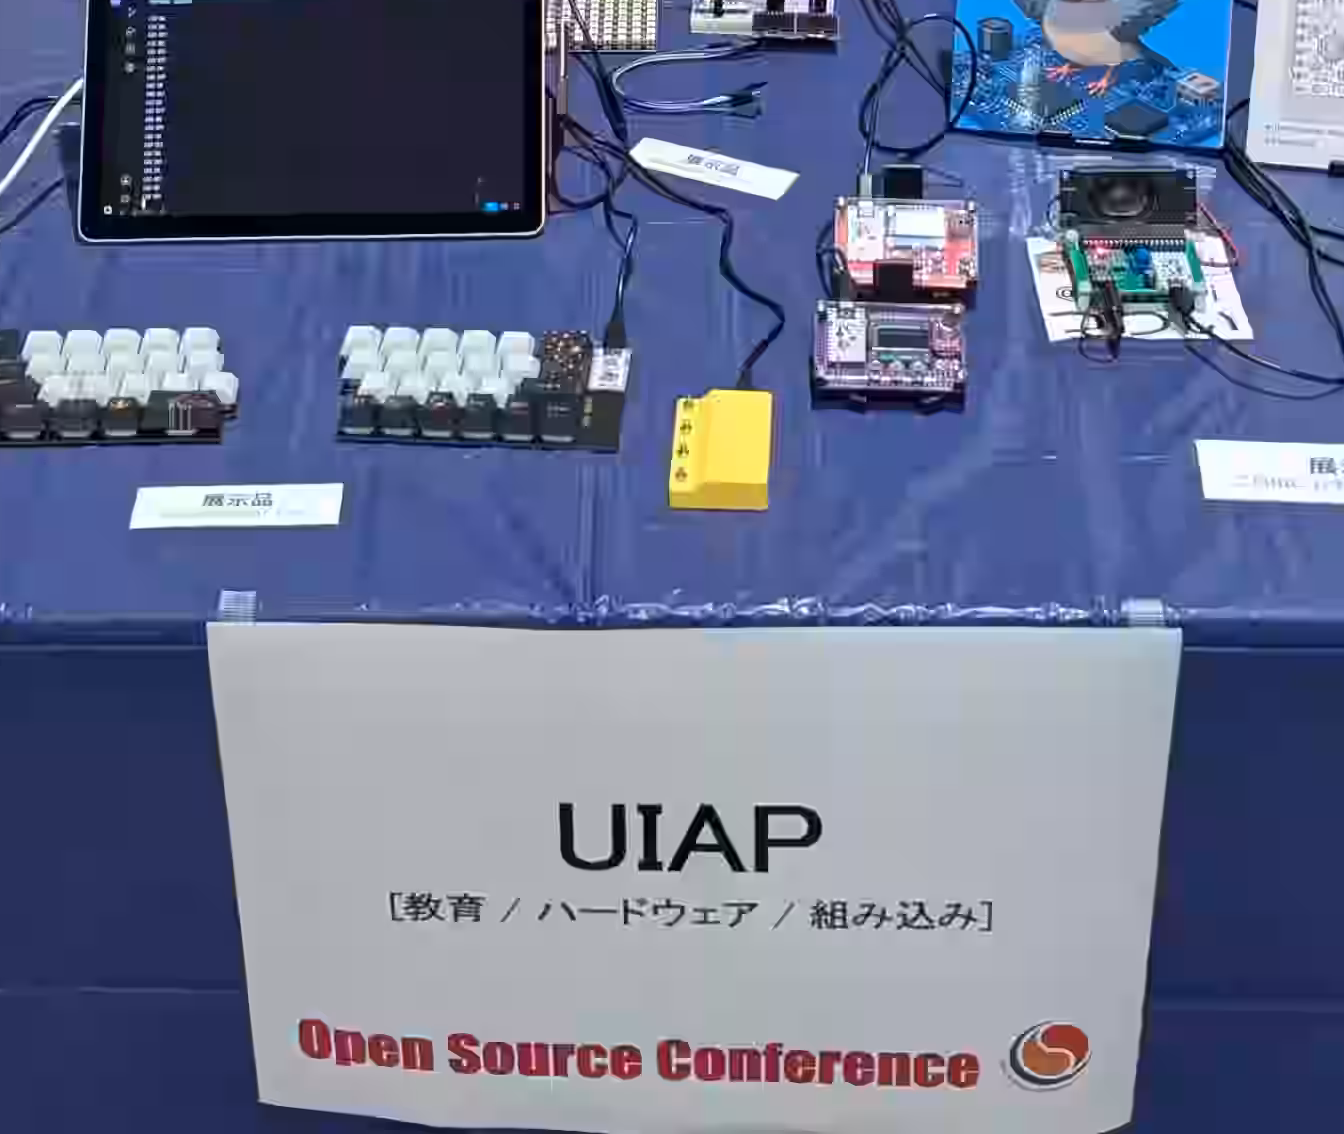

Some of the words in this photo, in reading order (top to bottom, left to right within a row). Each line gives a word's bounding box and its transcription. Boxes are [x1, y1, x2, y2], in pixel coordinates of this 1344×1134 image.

[559, 802, 824, 872] UIAP
[538, 896, 761, 928] ハードウェア
[298, 1017, 435, 1072] Open
[447, 1032, 643, 1080] Source
[656, 1038, 981, 1089] Conference
